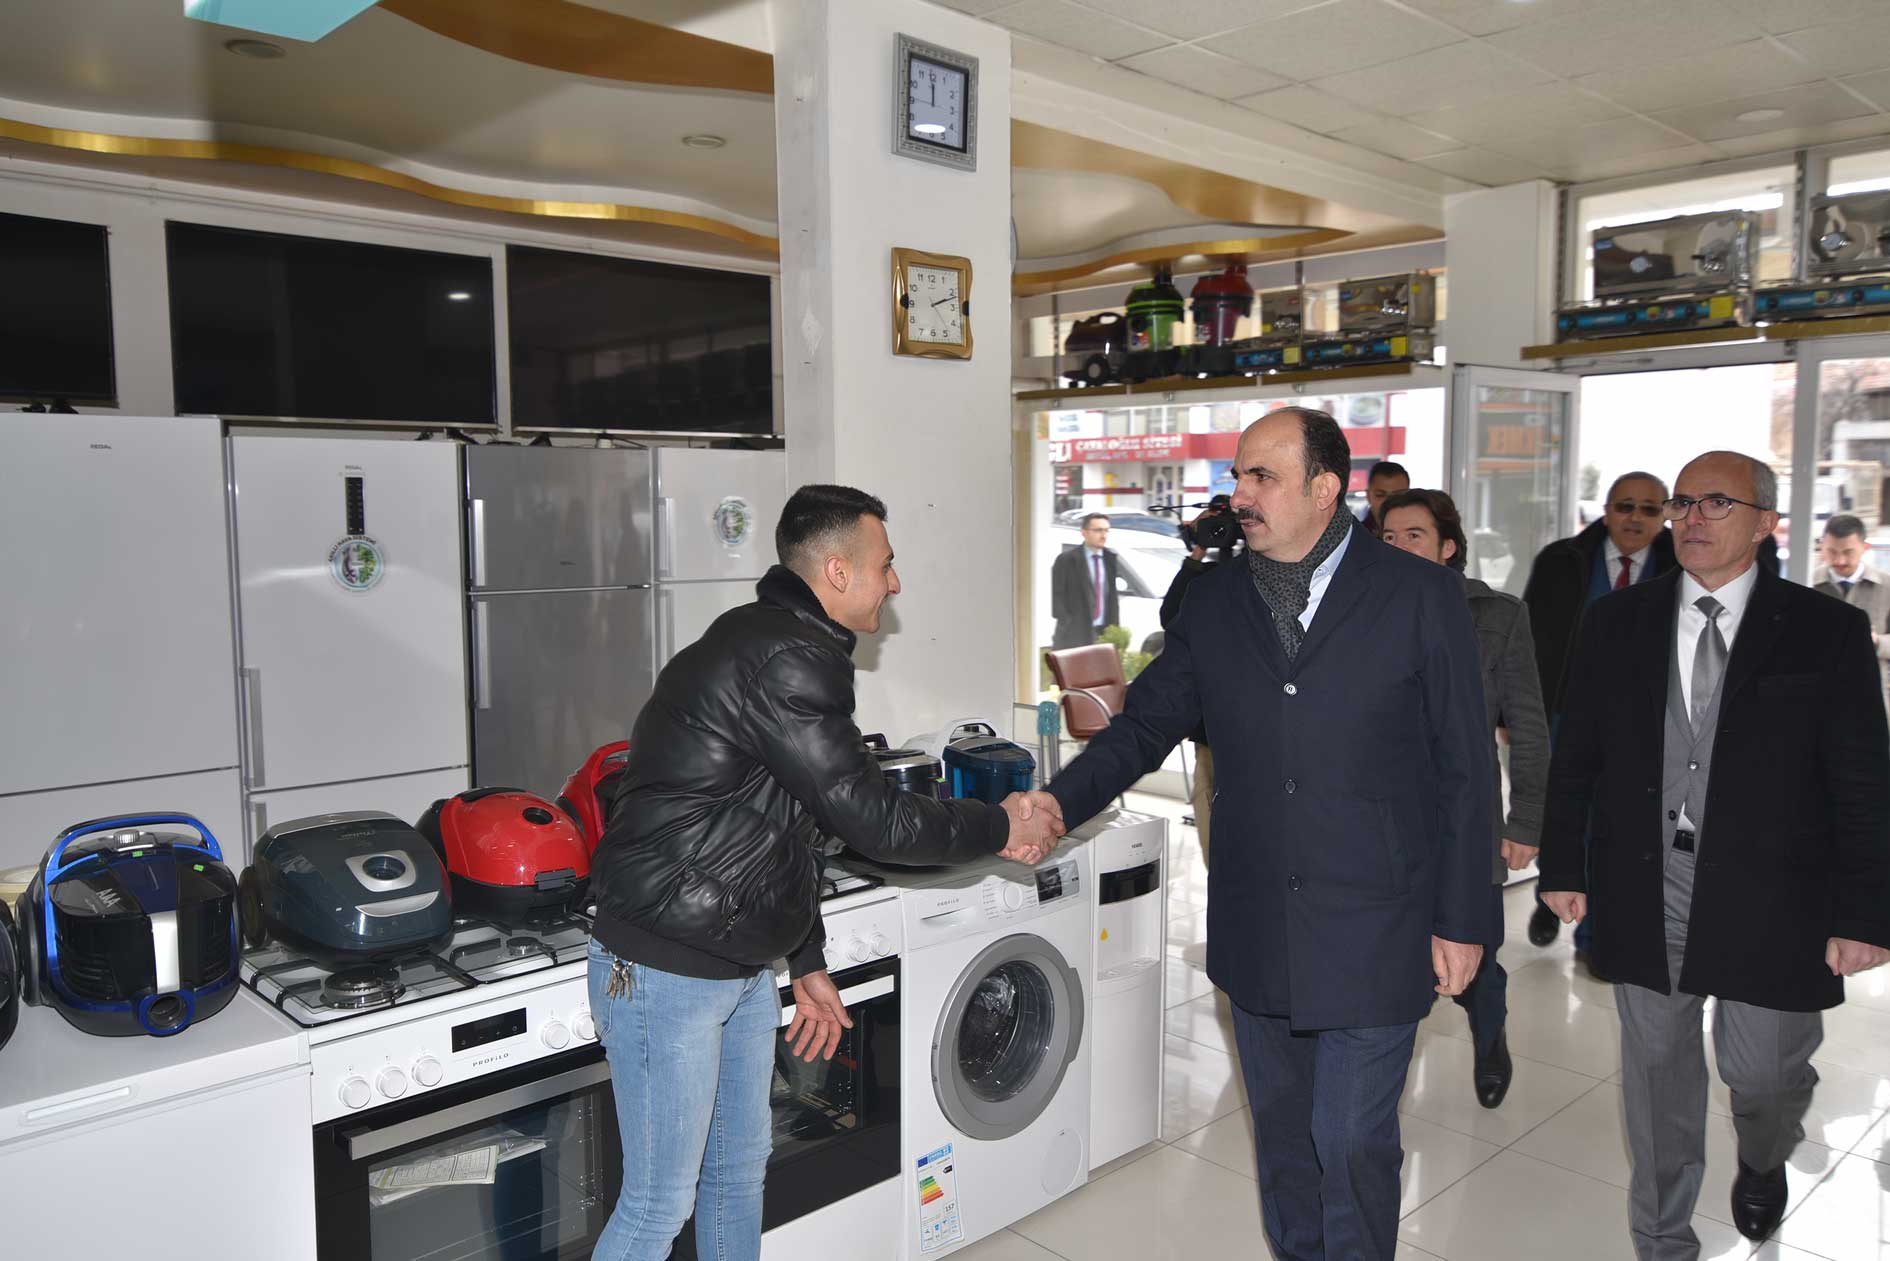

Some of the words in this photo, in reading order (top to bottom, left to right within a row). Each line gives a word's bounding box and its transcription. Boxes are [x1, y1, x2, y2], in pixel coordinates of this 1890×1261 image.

[917, 273, 924, 282] 11
[927, 275, 936, 283] 12
[941, 276, 945, 284] 1
[909, 284, 918, 293] 10
[949, 288, 955, 296] 2
[909, 299, 915, 308] 9
[950, 303, 955, 312] 3
[909, 315, 915, 324] 8
[919, 327, 924, 336] 7
[930, 328, 936, 337] 6
[942, 329, 948, 338] 5
